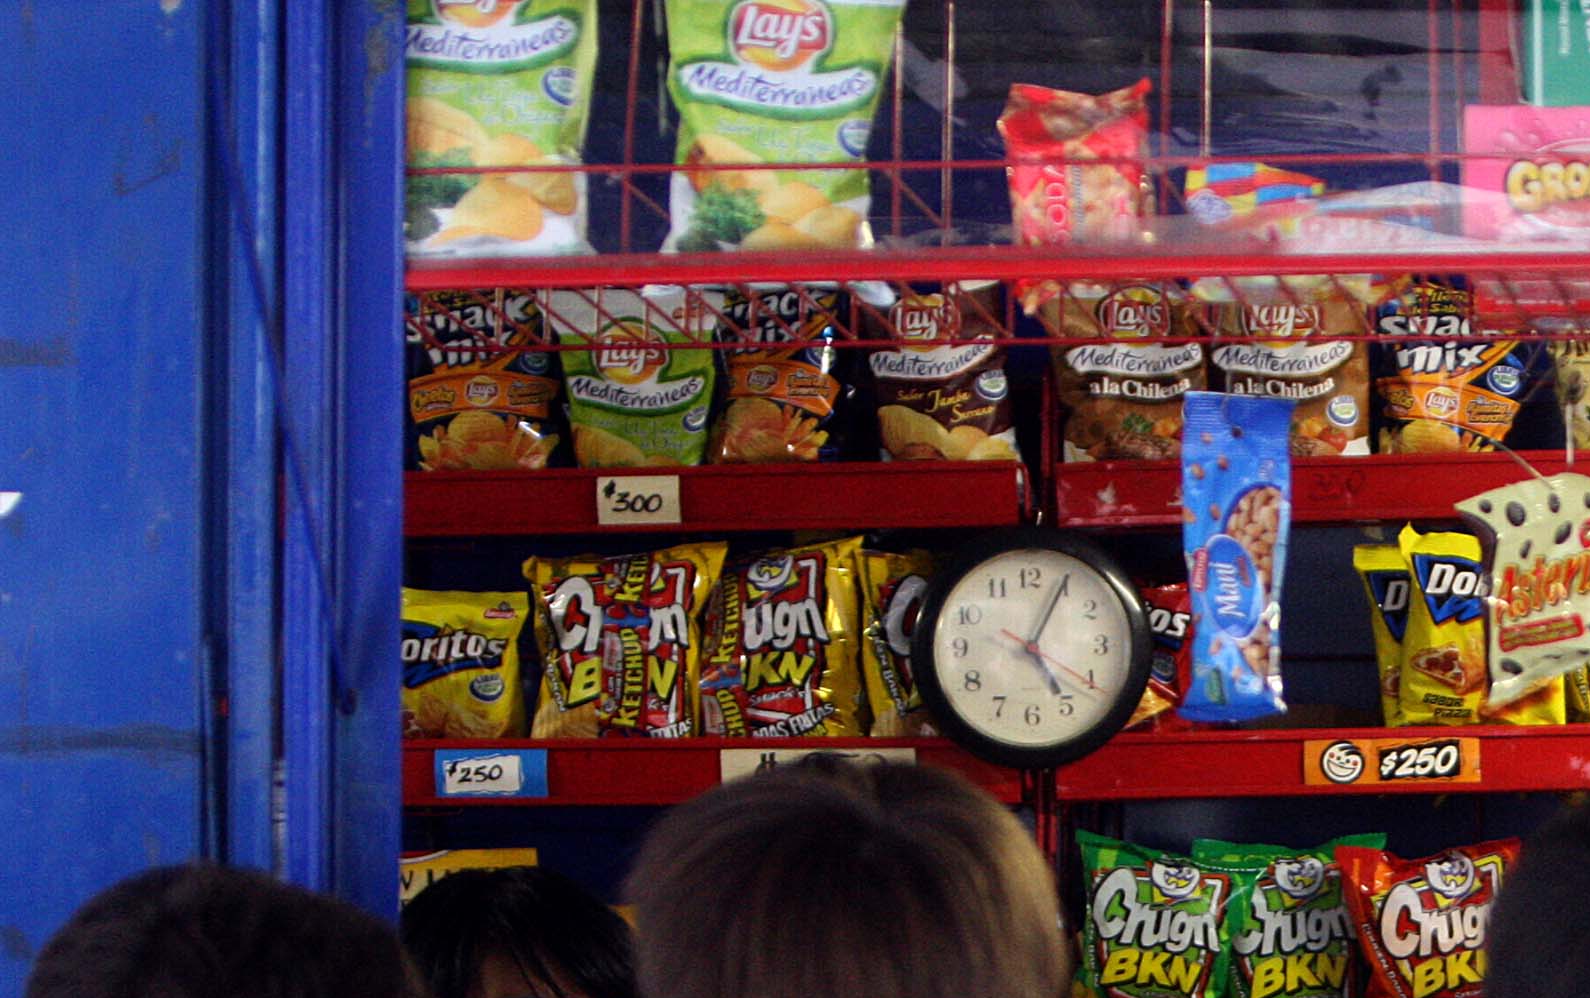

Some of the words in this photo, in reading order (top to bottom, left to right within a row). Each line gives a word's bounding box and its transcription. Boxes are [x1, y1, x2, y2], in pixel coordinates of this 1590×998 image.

[1071, 342, 1201, 374] Mediterraneas
[1216, 341, 1352, 374] Mediterraneas
[1396, 342, 1488, 374] mix
[570, 377, 701, 409] Mediterraneas
[1090, 380, 1101, 395] a
[1102, 376, 1121, 395] la
[1121, 377, 1192, 400] Chilena
[1265, 377, 1336, 400] Chilena
[1018, 567, 1043, 590] 12
[957, 604, 983, 627] 10
[1083, 599, 1098, 620] 2
[743, 598, 832, 652] ugn
[401, 626, 508, 662] oritos
[952, 637, 968, 658] 9
[1093, 635, 1110, 657] 3
[611, 626, 646, 728] KETCHUP
[739, 651, 817, 692] KN
[964, 670, 982, 693] 8
[991, 695, 1008, 723] 7
[1024, 705, 1041, 727] 6
[1059, 694, 1075, 717] 5
[1379, 744, 1460, 780] $250
[1100, 948, 1202, 994] BKN
